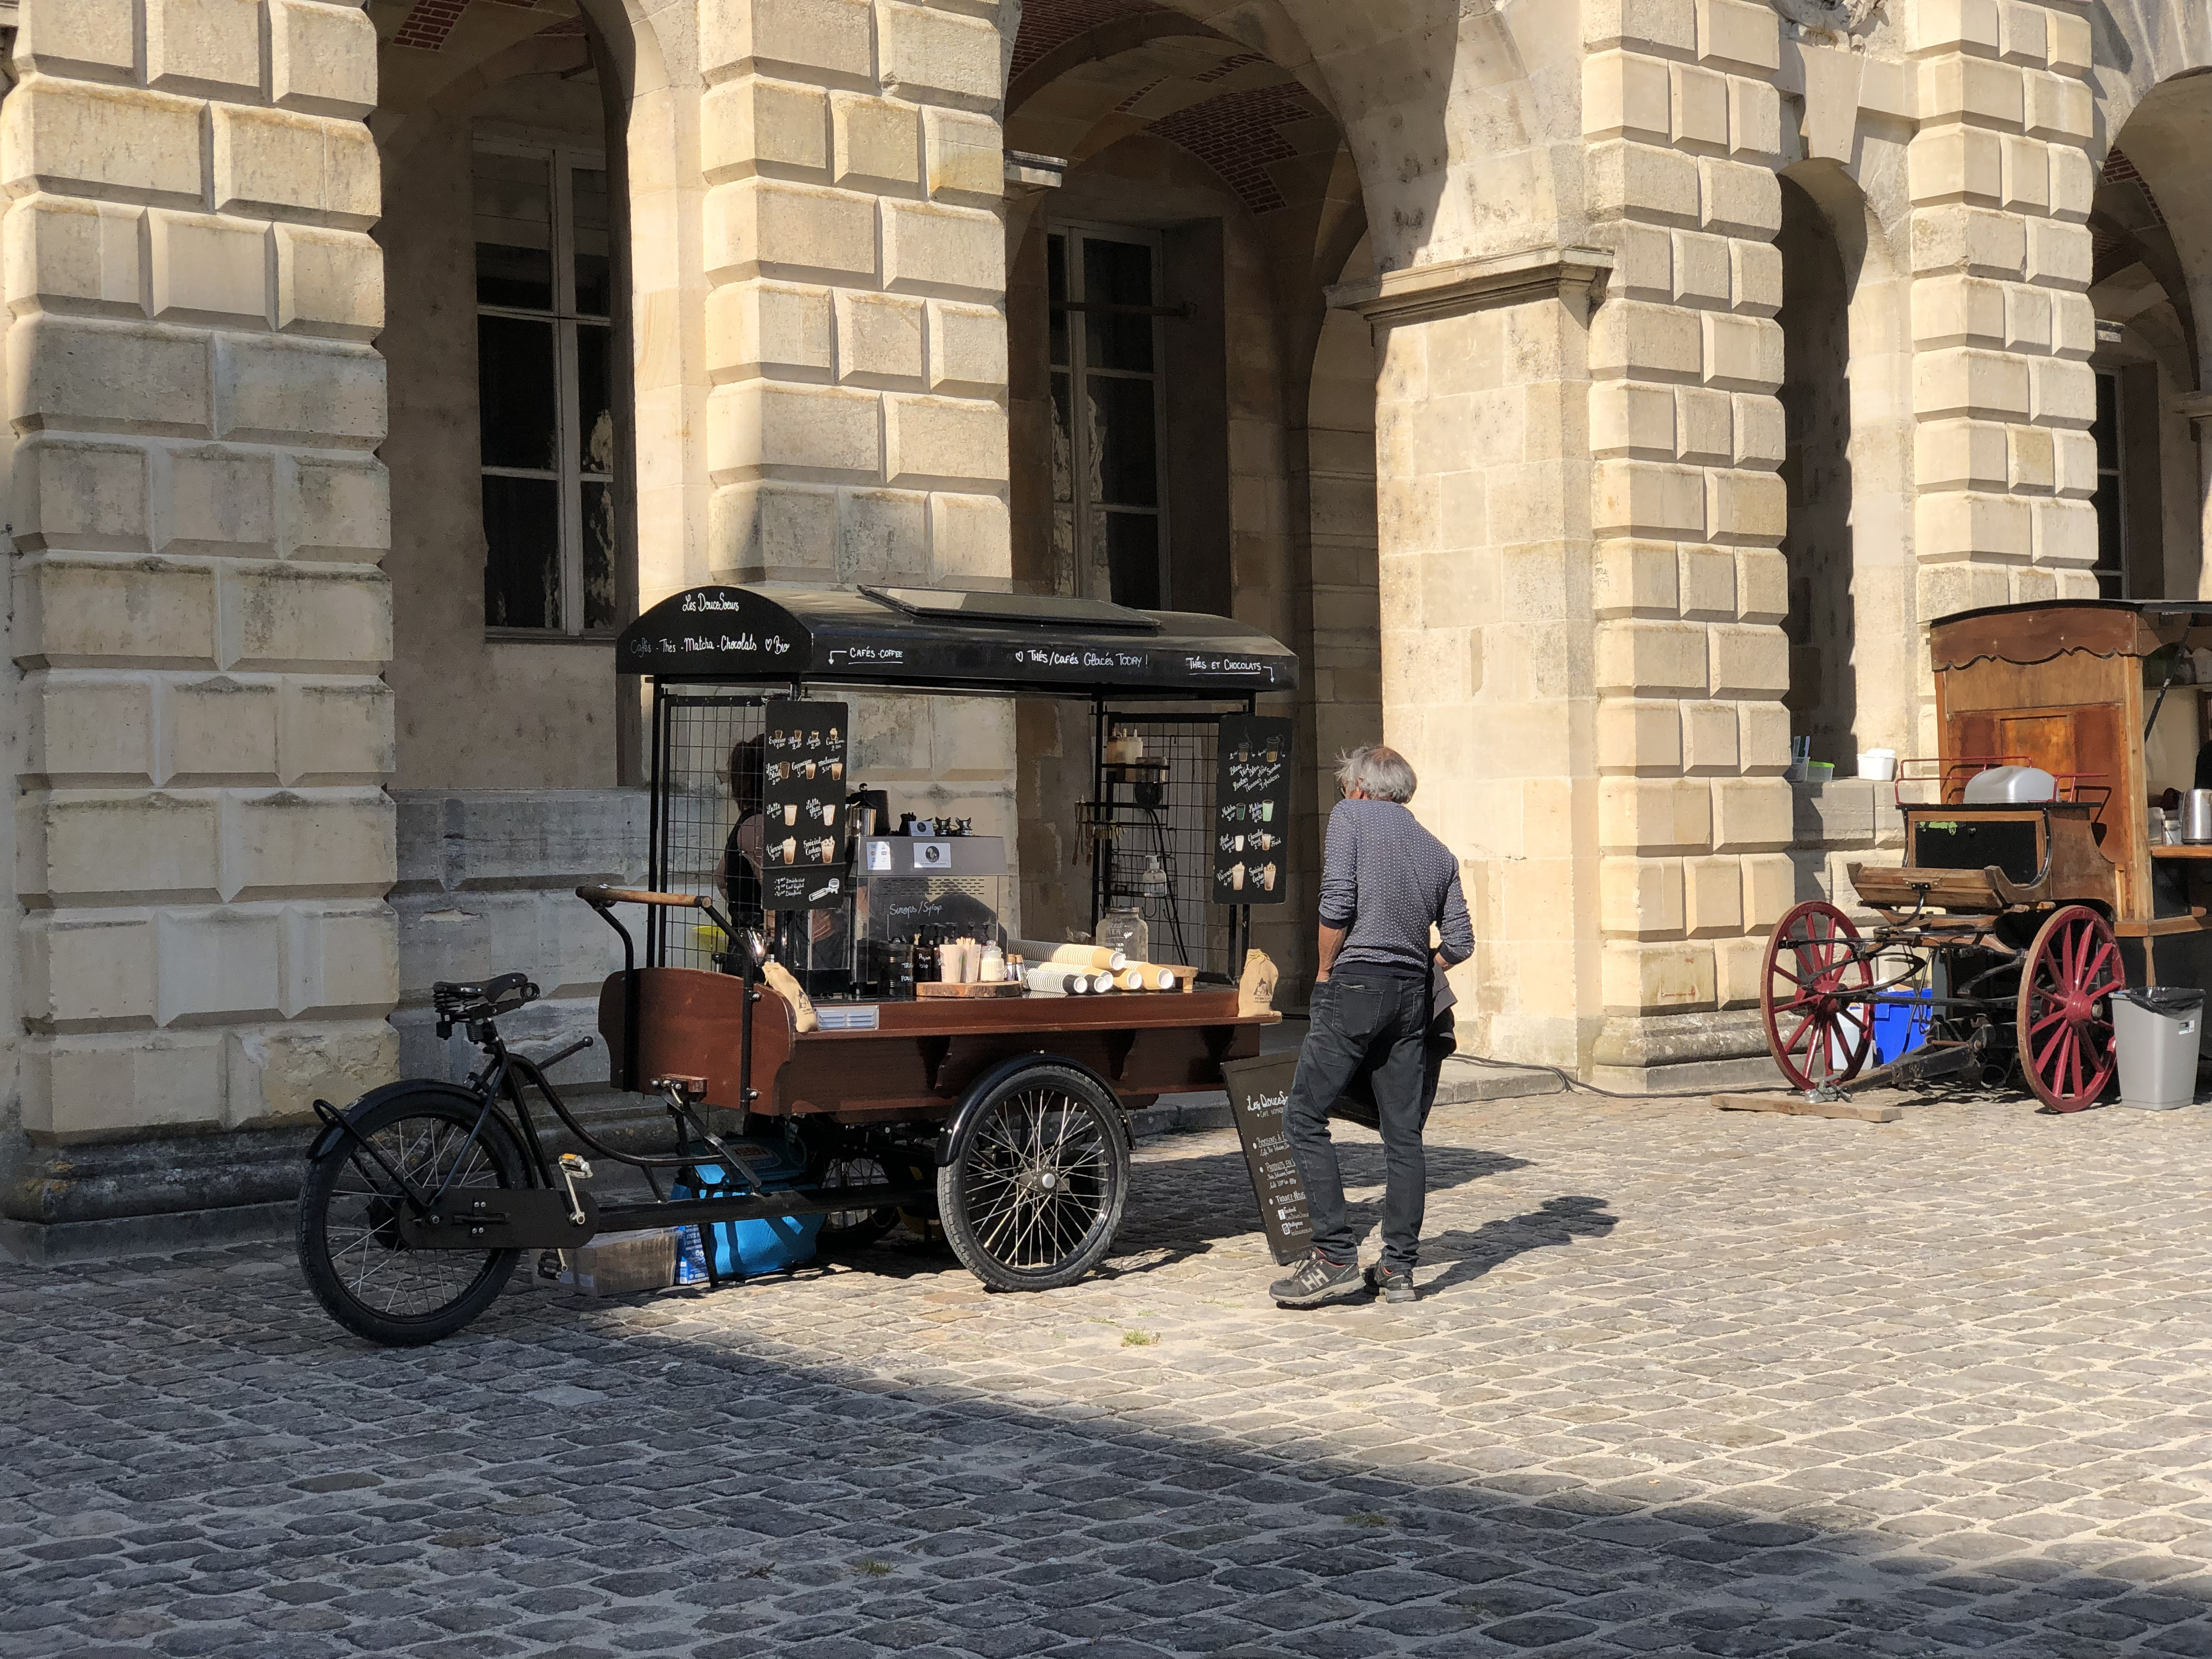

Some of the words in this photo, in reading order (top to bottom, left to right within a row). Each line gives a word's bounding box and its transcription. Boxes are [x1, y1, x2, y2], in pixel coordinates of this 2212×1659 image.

[682, 594, 696, 612] Les
[630, 637, 651, 658] Cafés
[659, 638, 676, 653] Thés
[684, 635, 714, 652] Matcha
[721, 632, 757, 651] Chocolats
[774, 635, 790, 654] Bio
[1084, 652, 1113, 666] Glacés
[766, 802, 781, 815] Latte
[1246, 1095, 1261, 1112] Les
[1302, 1269, 1329, 1291] HH
